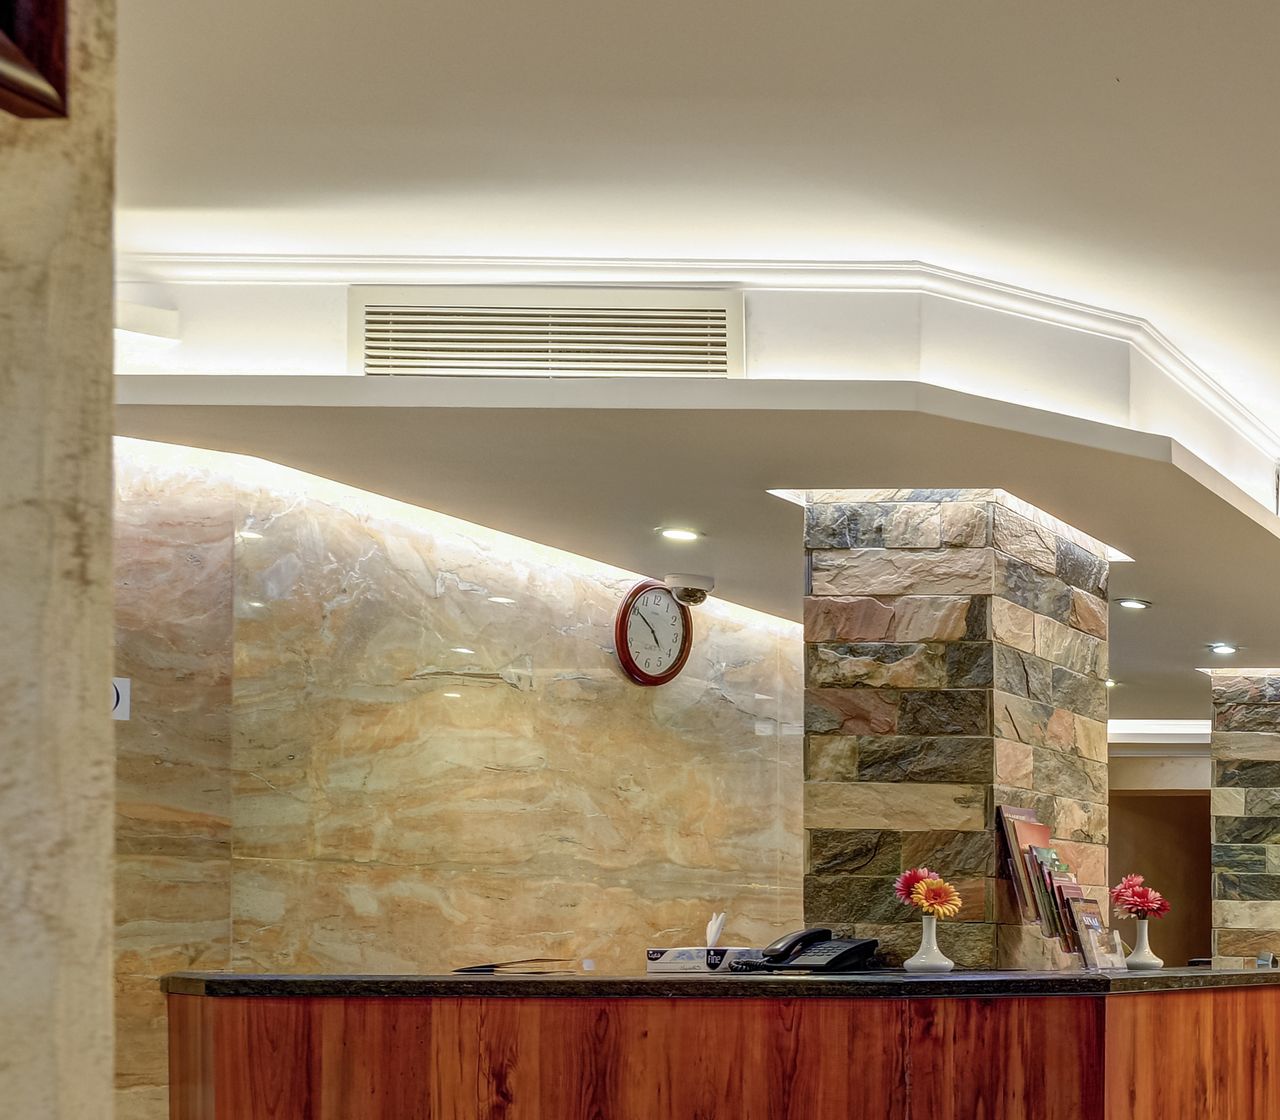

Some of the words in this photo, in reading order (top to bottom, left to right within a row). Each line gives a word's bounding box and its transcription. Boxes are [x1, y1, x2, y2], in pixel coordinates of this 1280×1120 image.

[642, 596, 648, 606] 11
[653, 595, 661, 606] 12
[671, 616, 677, 625] 2
[672, 633, 678, 643] 3
[635, 651, 640, 661] 7
[666, 648, 671, 657] 4
[645, 658, 650, 668] 6
[657, 656, 662, 667] 5
